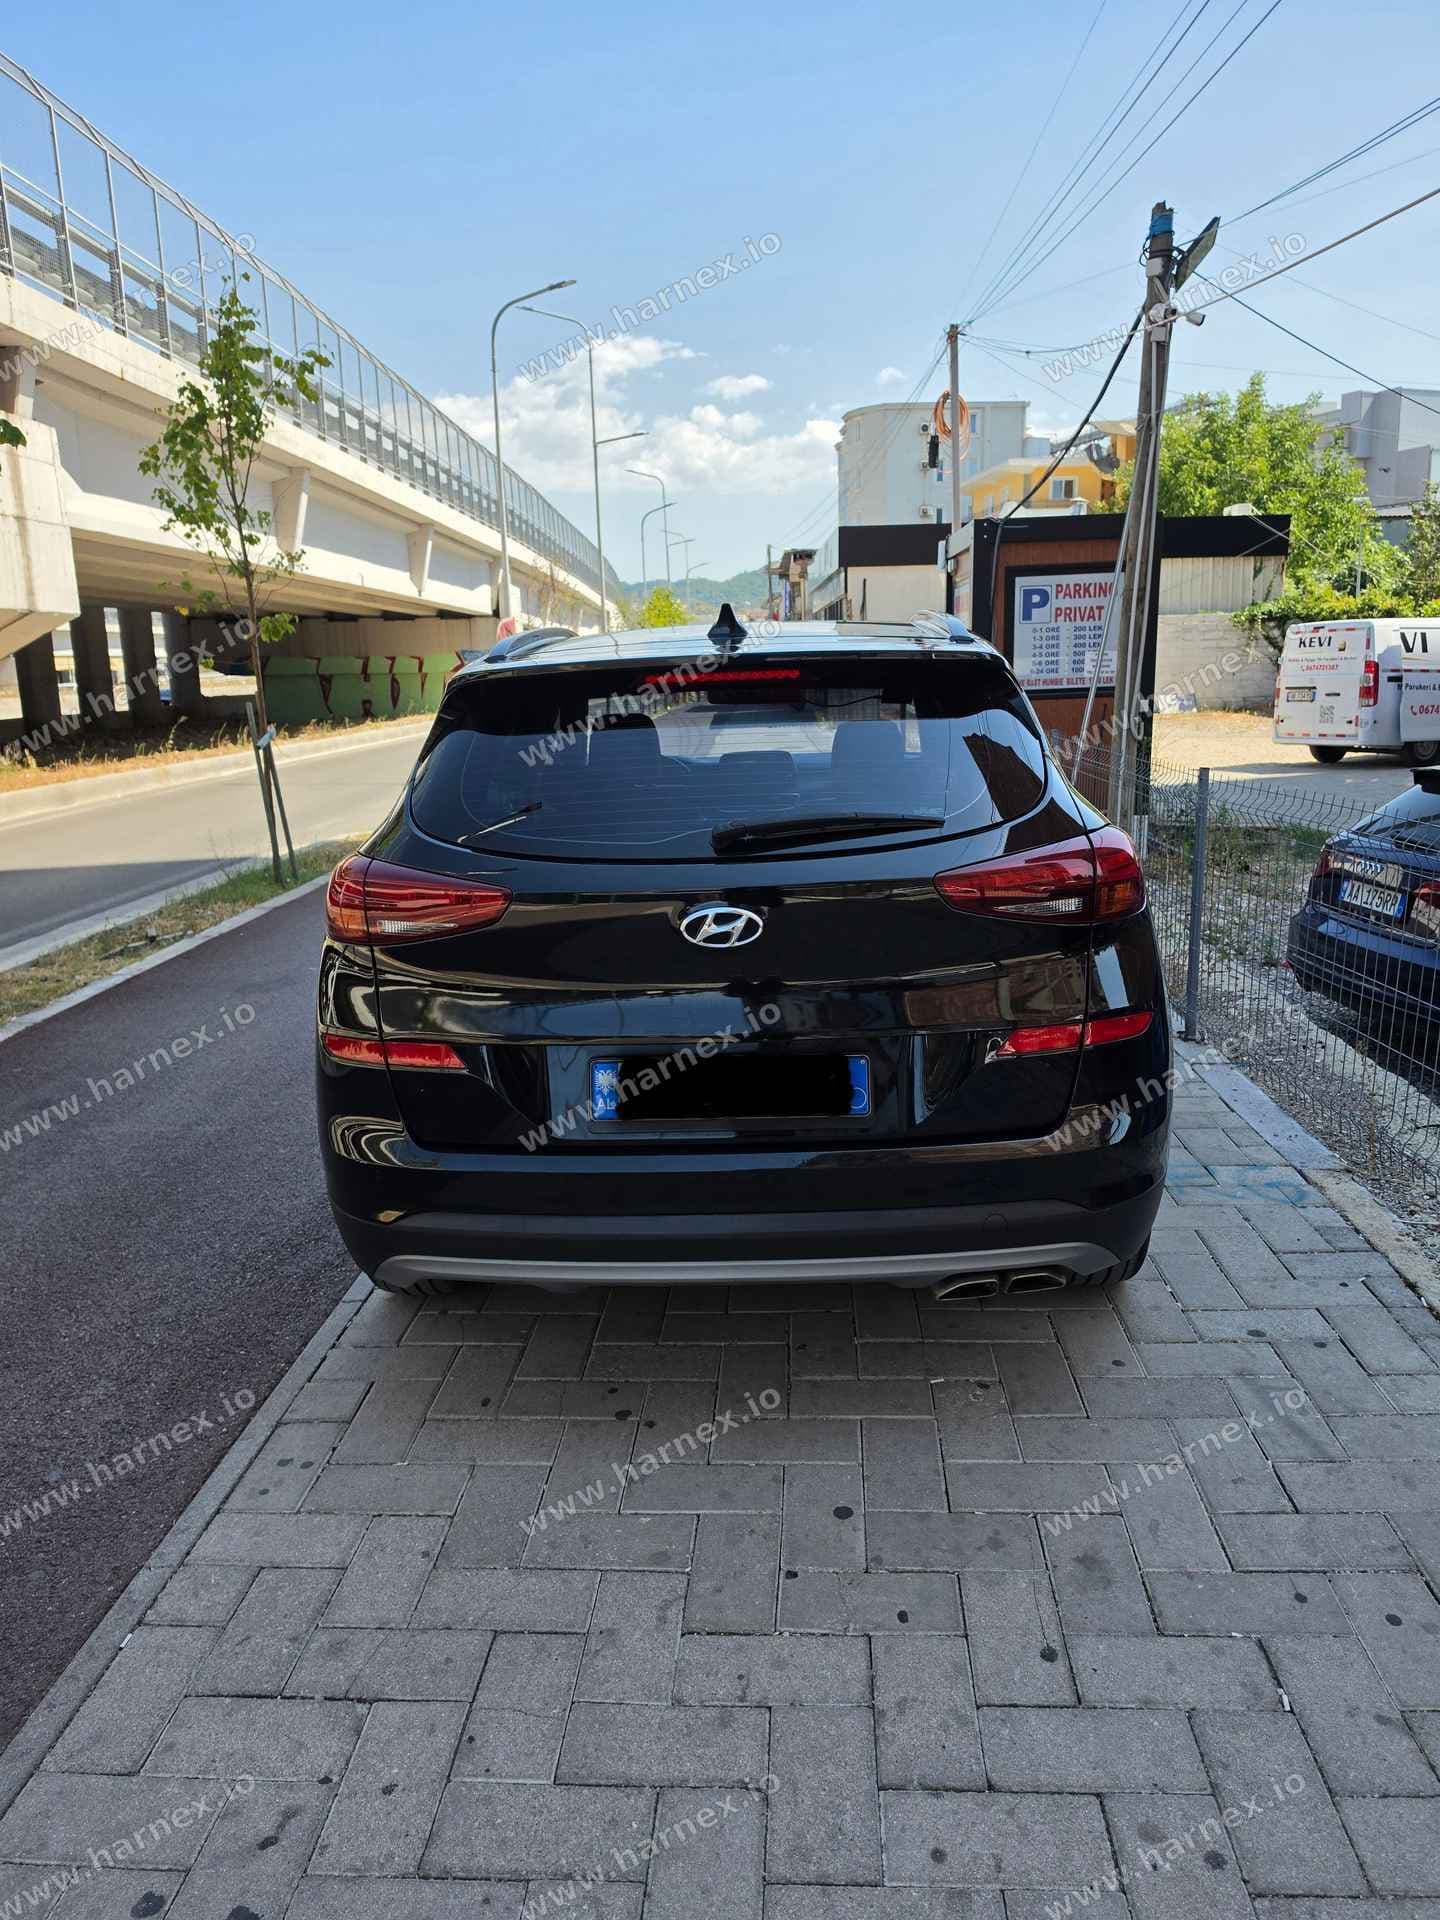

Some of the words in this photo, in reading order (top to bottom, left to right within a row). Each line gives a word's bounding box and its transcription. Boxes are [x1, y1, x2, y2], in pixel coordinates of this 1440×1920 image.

[1022, 588, 1049, 621] P
[1055, 606, 1104, 623] PRIVAT
[1299, 635, 1332, 648] KEVI
[1400, 631, 1428, 653] VI
